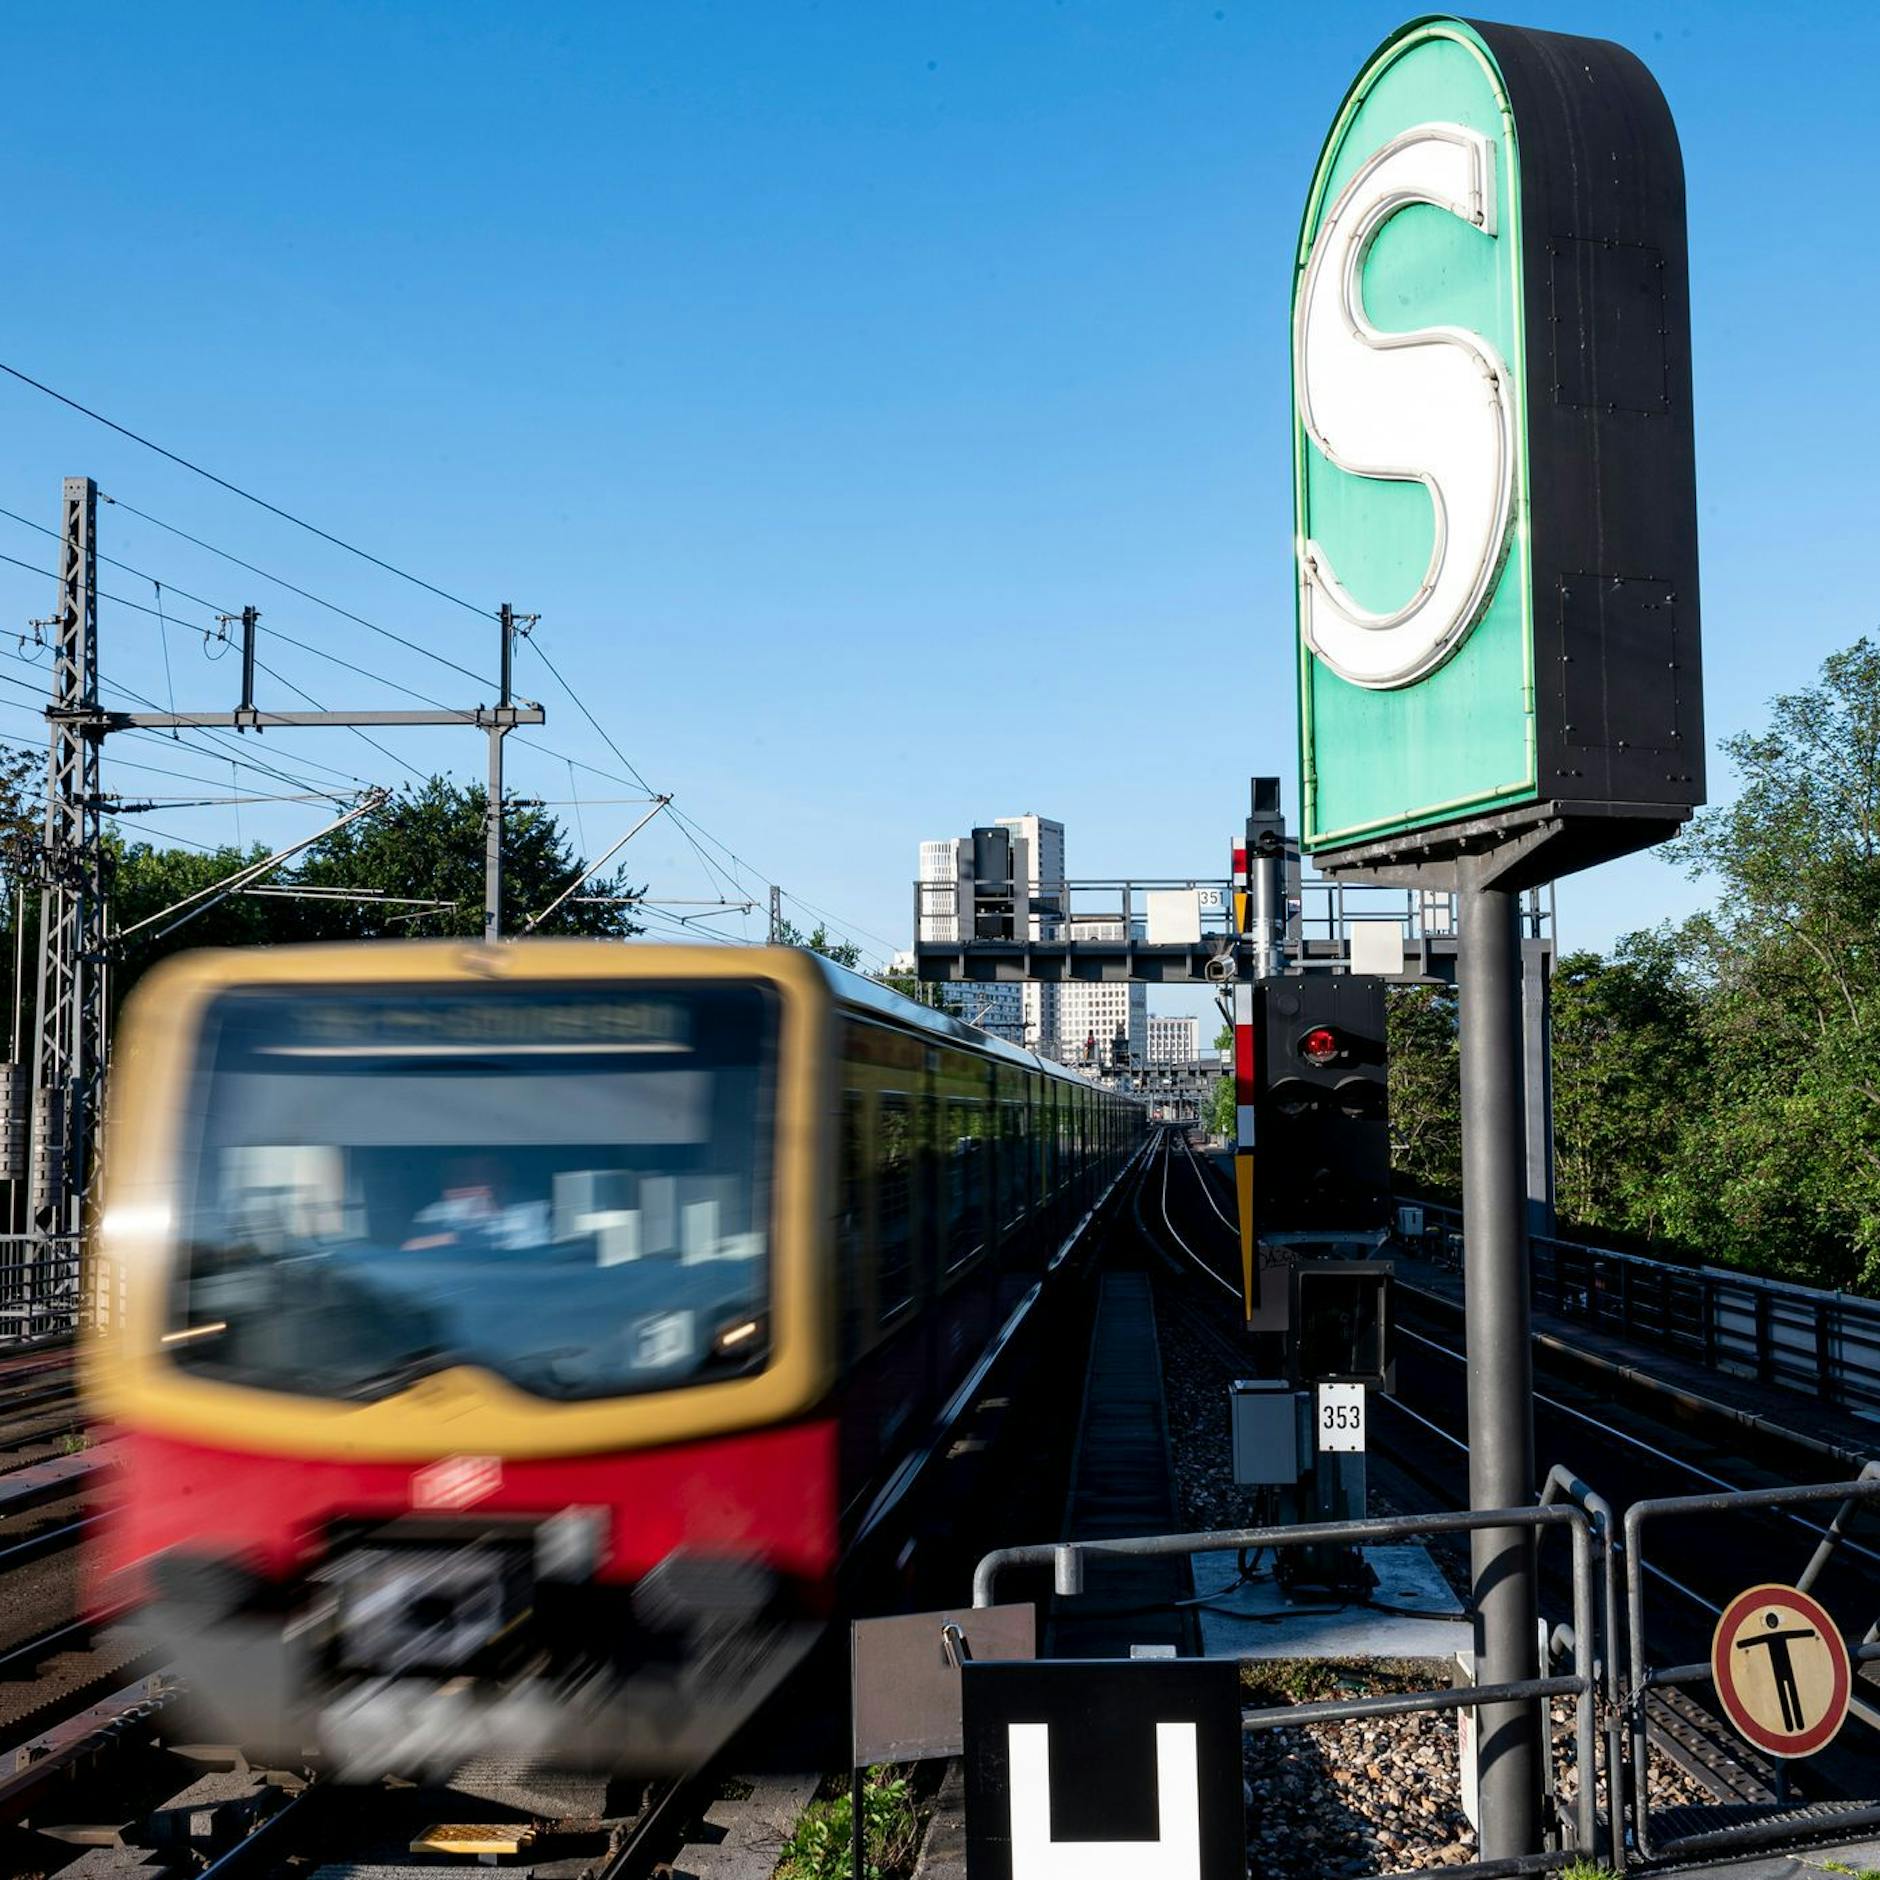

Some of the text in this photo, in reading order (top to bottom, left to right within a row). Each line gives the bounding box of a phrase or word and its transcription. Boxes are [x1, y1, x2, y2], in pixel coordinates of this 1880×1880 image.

[1297, 121, 1515, 690] S
[1200, 891, 1224, 905] 351
[1323, 1405, 1361, 1430] 353
